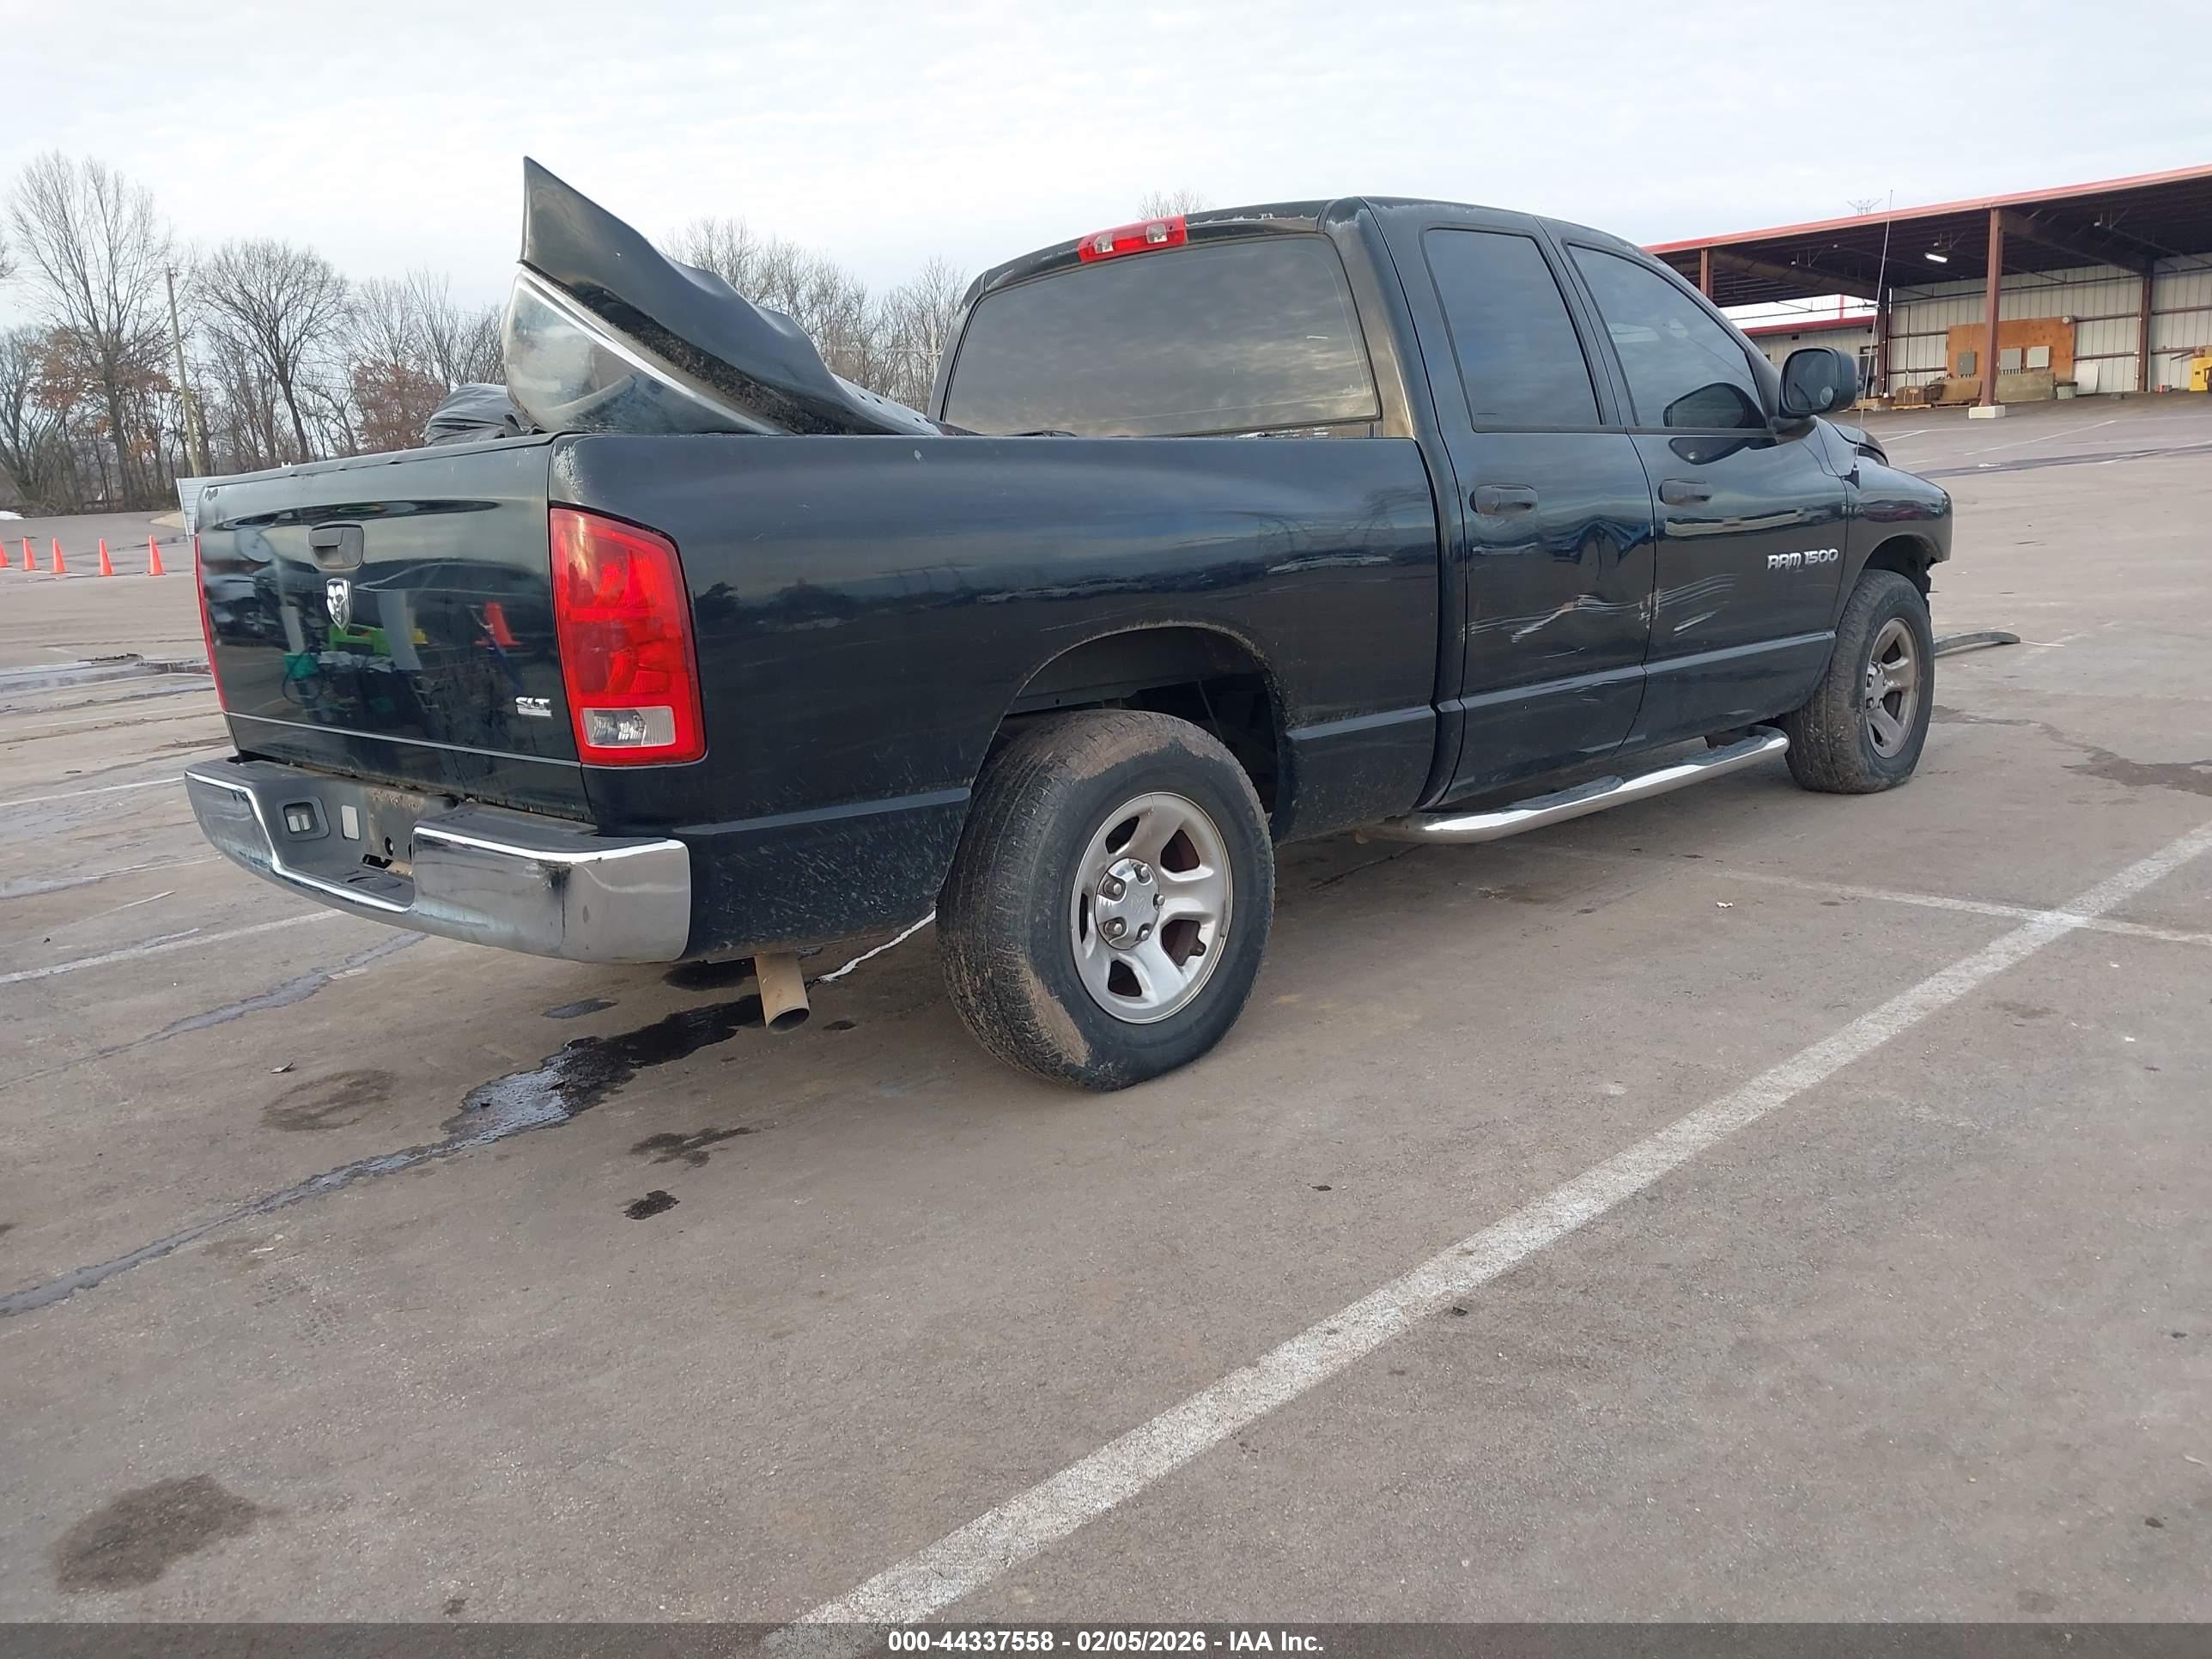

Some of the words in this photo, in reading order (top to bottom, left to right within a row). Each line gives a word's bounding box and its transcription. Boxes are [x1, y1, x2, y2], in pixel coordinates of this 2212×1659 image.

[1766, 552, 1802, 570] RAM
[1803, 548, 1838, 564] 1500
[515, 696, 550, 710] SLT
